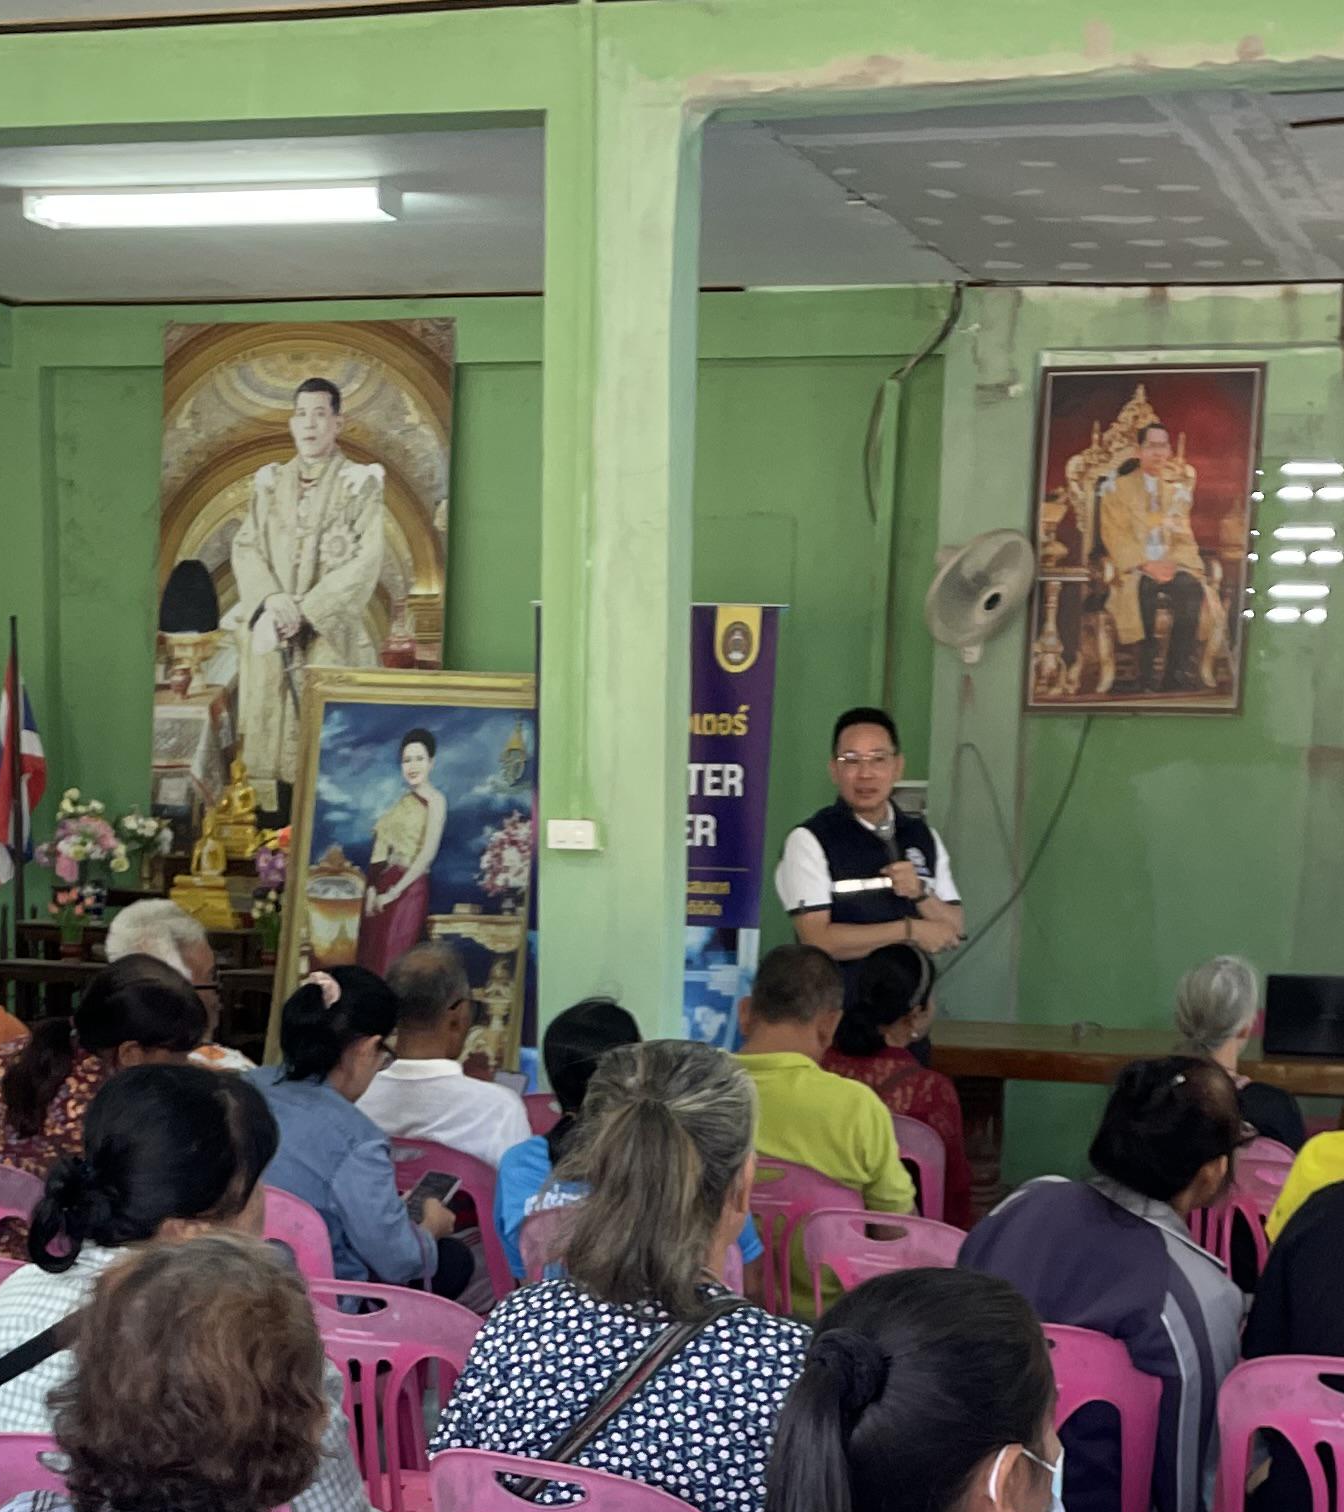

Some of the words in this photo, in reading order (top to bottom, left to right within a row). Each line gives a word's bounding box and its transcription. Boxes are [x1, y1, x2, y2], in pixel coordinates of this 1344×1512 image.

[689, 703, 751, 736] เตอร์
[687, 763, 745, 797] TER
[686, 814, 718, 847] ER
